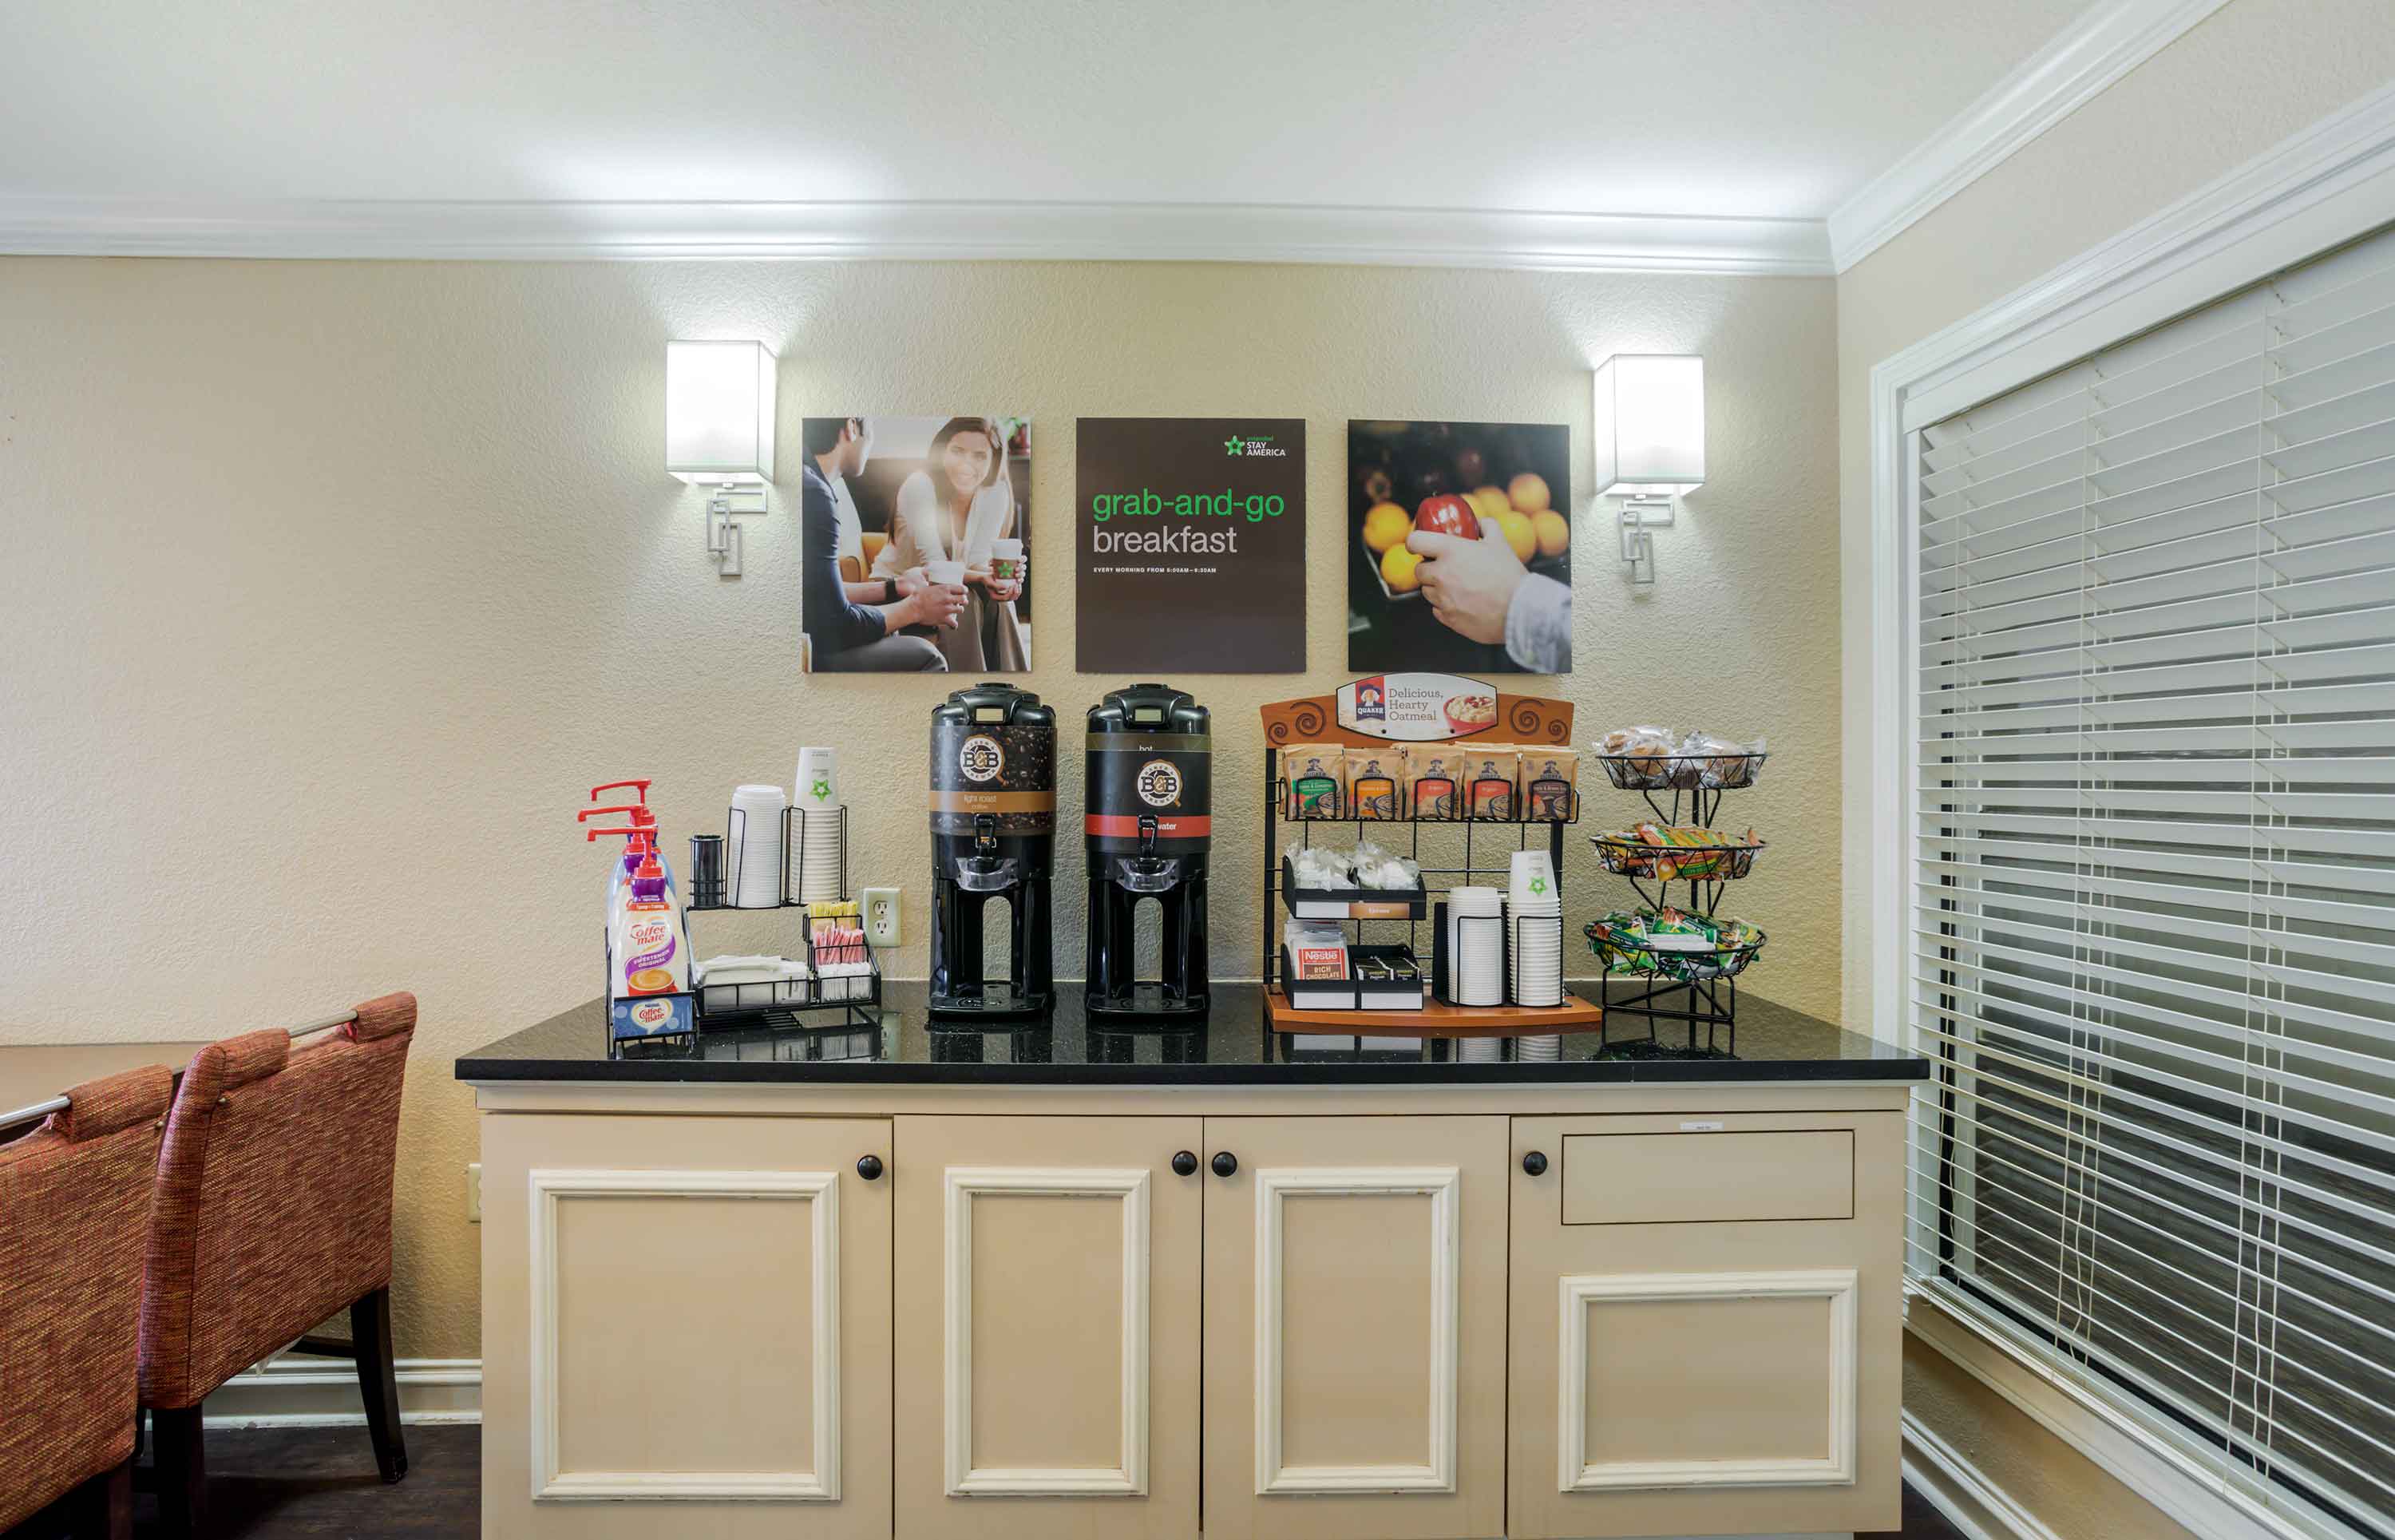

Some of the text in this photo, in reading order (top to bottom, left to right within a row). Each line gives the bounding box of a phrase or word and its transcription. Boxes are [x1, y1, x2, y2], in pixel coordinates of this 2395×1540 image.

[1092, 488, 1285, 522] grab-and-go
[1093, 525, 1237, 553] breakfast
[1389, 687, 1444, 699] Delicious,
[1389, 699, 1429, 712] Hearty
[1389, 710, 1438, 721] Oatmeal
[637, 932, 664, 945] mate
[1305, 972, 1340, 980] CHOCOLATE
